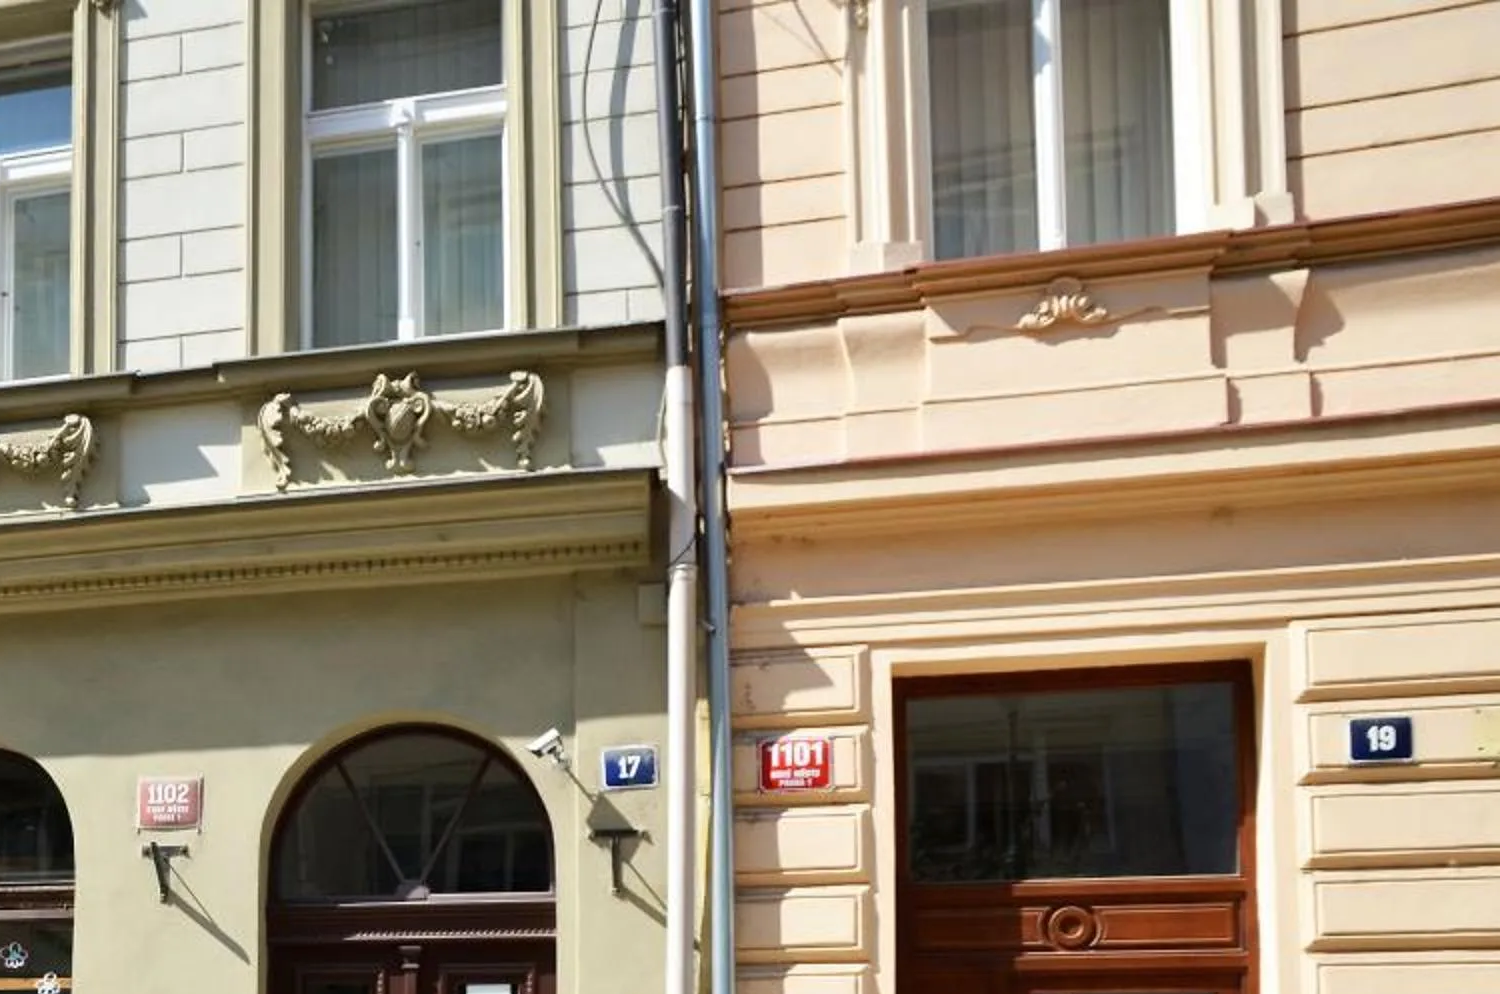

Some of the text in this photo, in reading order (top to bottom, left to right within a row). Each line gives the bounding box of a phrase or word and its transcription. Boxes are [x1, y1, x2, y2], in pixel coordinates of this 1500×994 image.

[1366, 725, 1397, 752] 19
[618, 755, 641, 779] 17
[767, 741, 823, 768] 1101
[148, 783, 190, 804] 1102
